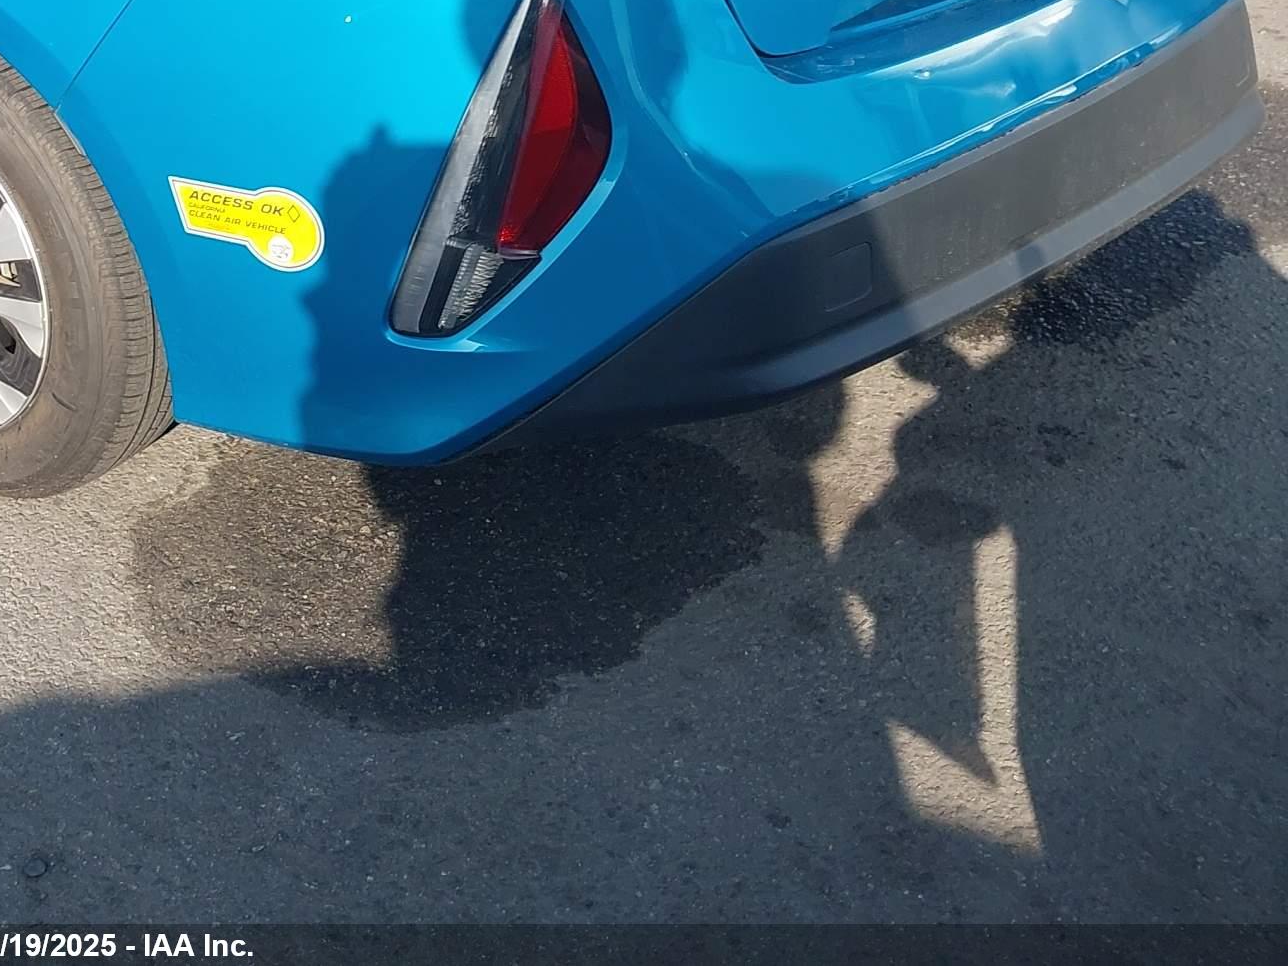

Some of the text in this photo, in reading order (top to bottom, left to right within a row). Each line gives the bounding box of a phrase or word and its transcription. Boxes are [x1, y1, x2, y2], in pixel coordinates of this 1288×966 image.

[189, 191, 285, 217] ACCESS OK
[188, 209, 221, 222] CLEAN
[224, 217, 241, 225] AIR
[245, 220, 287, 235] VEHICLE
